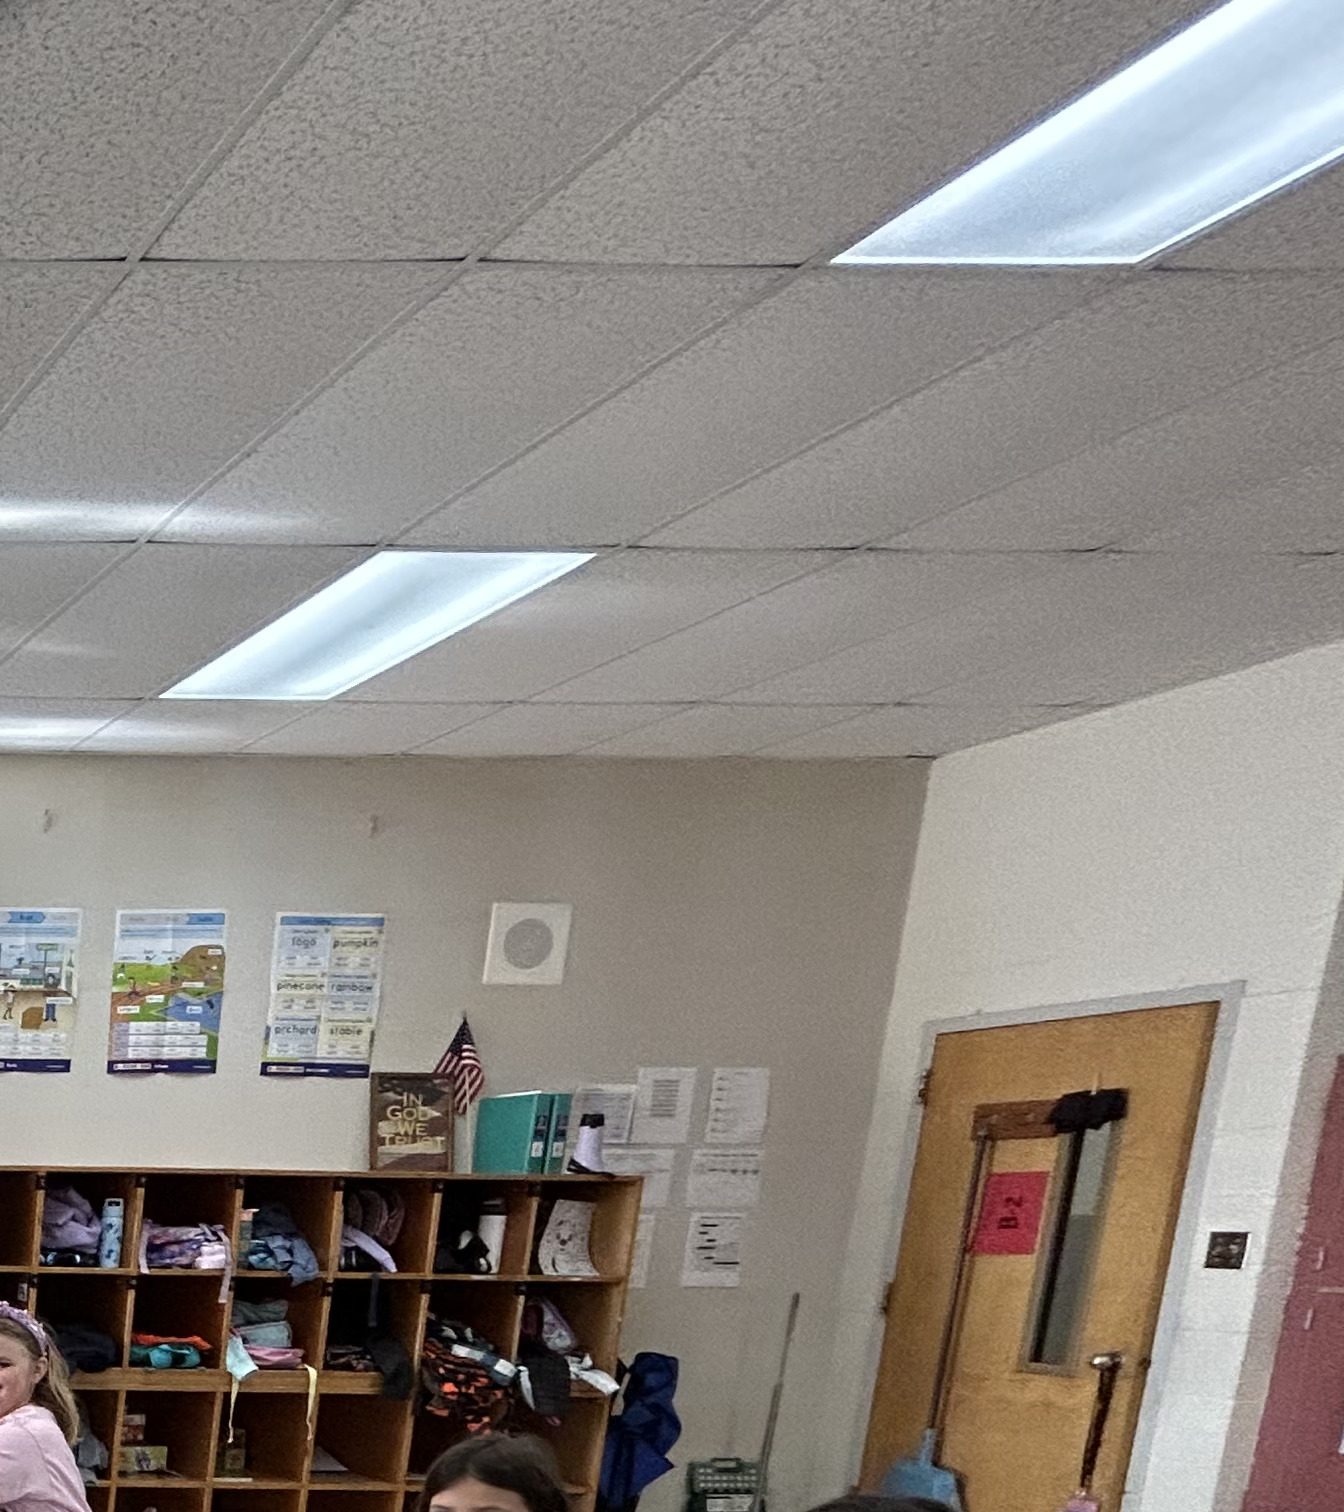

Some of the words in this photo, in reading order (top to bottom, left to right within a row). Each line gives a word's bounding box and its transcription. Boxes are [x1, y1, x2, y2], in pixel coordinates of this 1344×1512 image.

[402, 1092, 424, 1107] IN
[386, 1106, 430, 1120] GOD
[398, 1121, 429, 1136] WE
